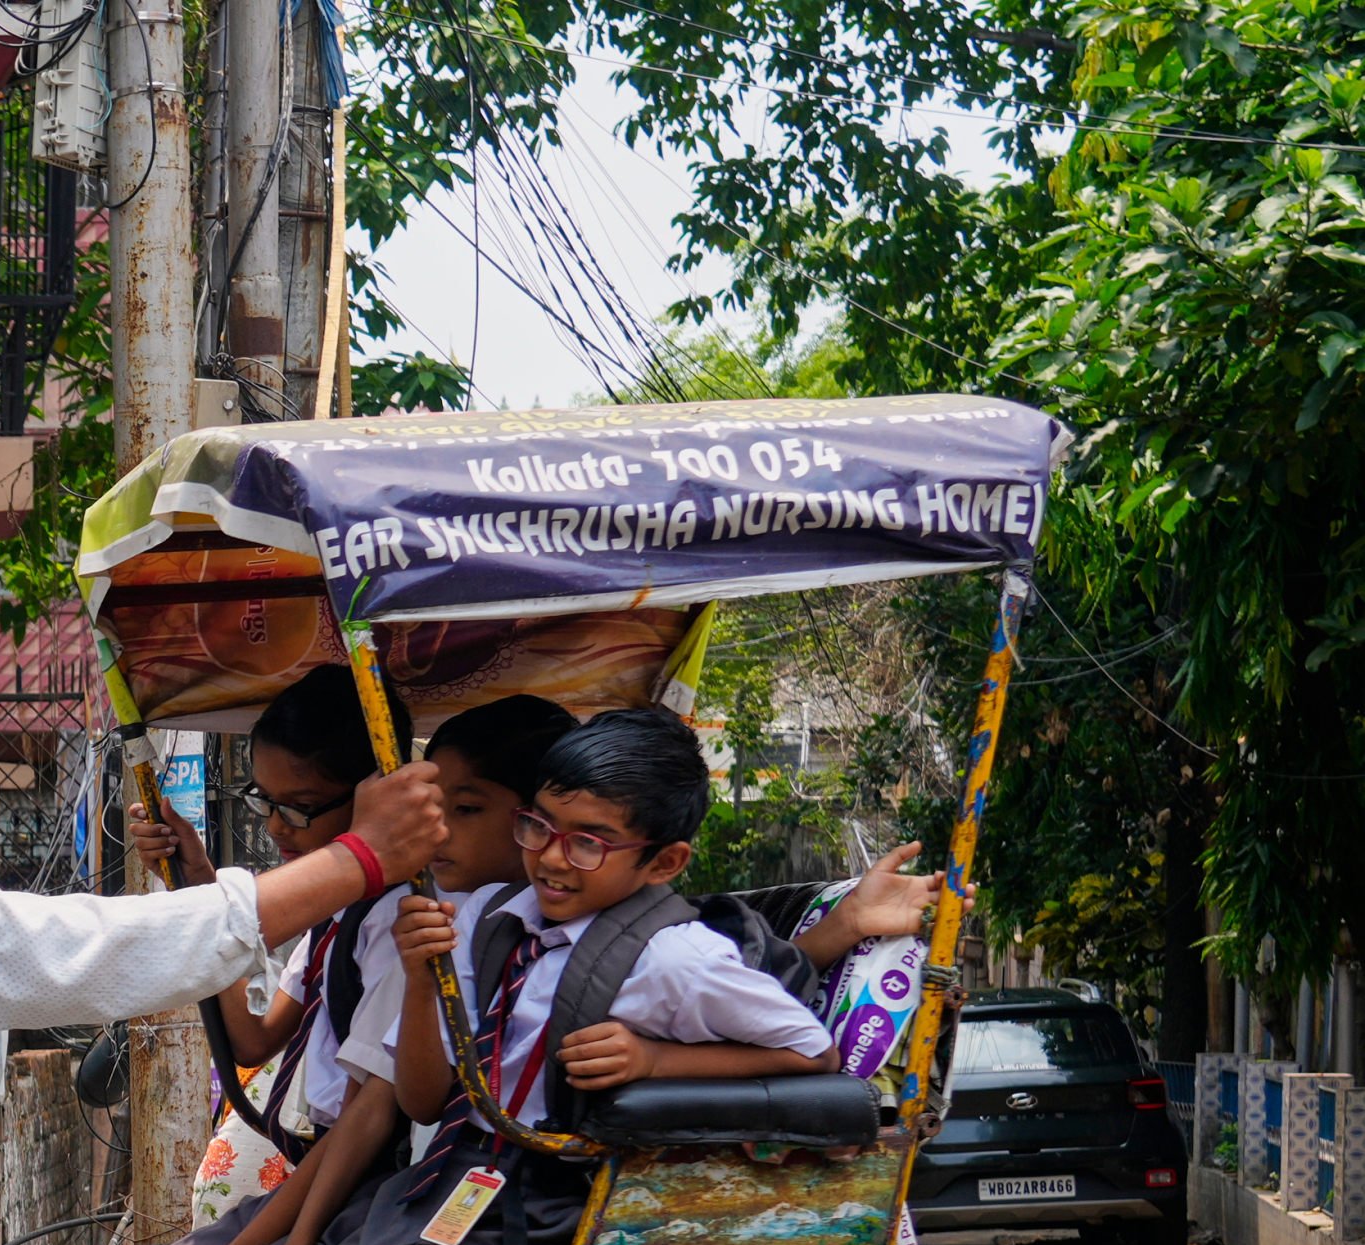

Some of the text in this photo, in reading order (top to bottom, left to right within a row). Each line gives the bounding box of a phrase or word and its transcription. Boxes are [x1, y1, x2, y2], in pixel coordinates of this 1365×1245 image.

[465, 451, 643, 494] Kolkata-
[747, 437, 843, 482] 054
[311, 517, 411, 580] EAR
[416, 499, 697, 563] SHUSHRUSHA
[711, 488, 905, 541] NURSING
[987, 1178, 1073, 1197] WB02AR8466
